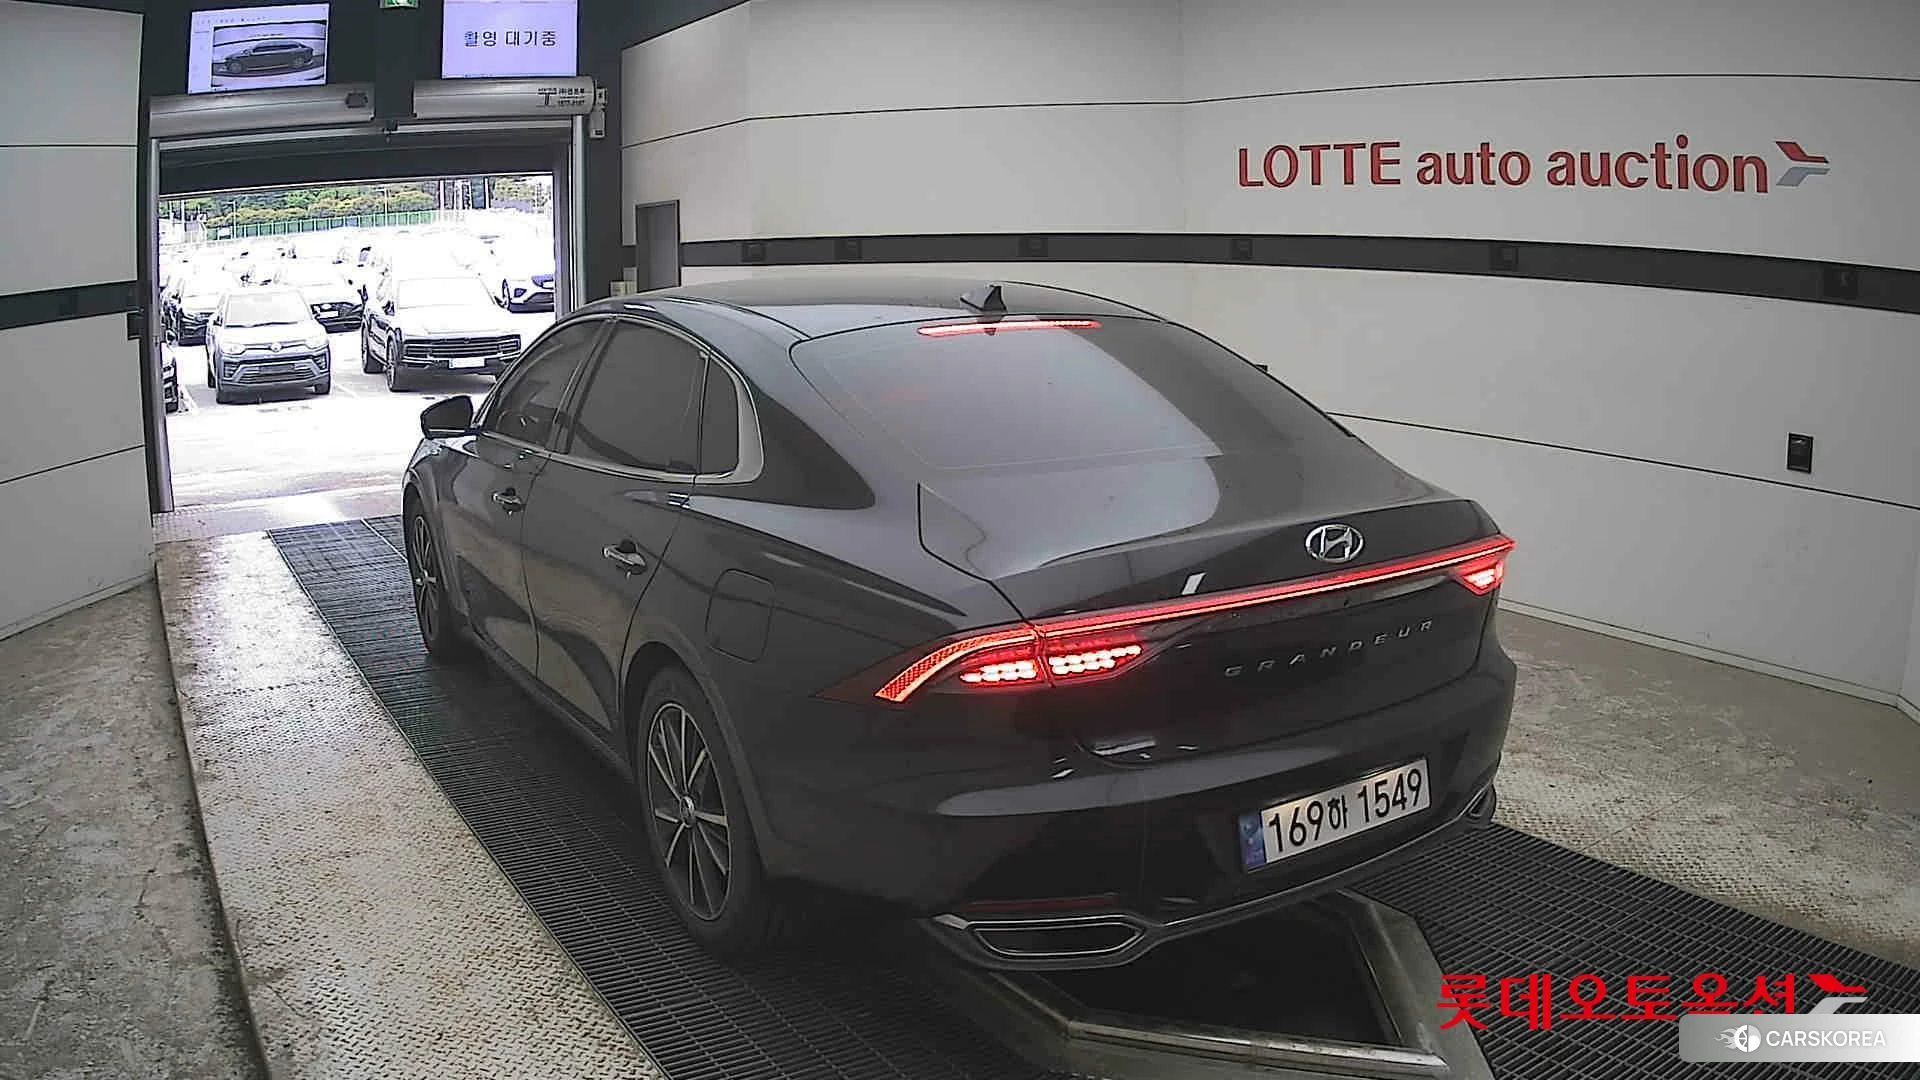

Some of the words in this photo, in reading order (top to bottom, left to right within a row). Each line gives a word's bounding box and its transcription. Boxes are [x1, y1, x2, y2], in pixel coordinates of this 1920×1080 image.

[505, 30, 557, 47] 대기중
[1238, 141, 1401, 188] LOTTE
[1416, 141, 1531, 186] auto
[1546, 134, 1769, 194] auction
[1224, 619, 1433, 677] GRANDEUR
[1268, 795, 1348, 852] 169하
[1358, 768, 1422, 823] 1549
